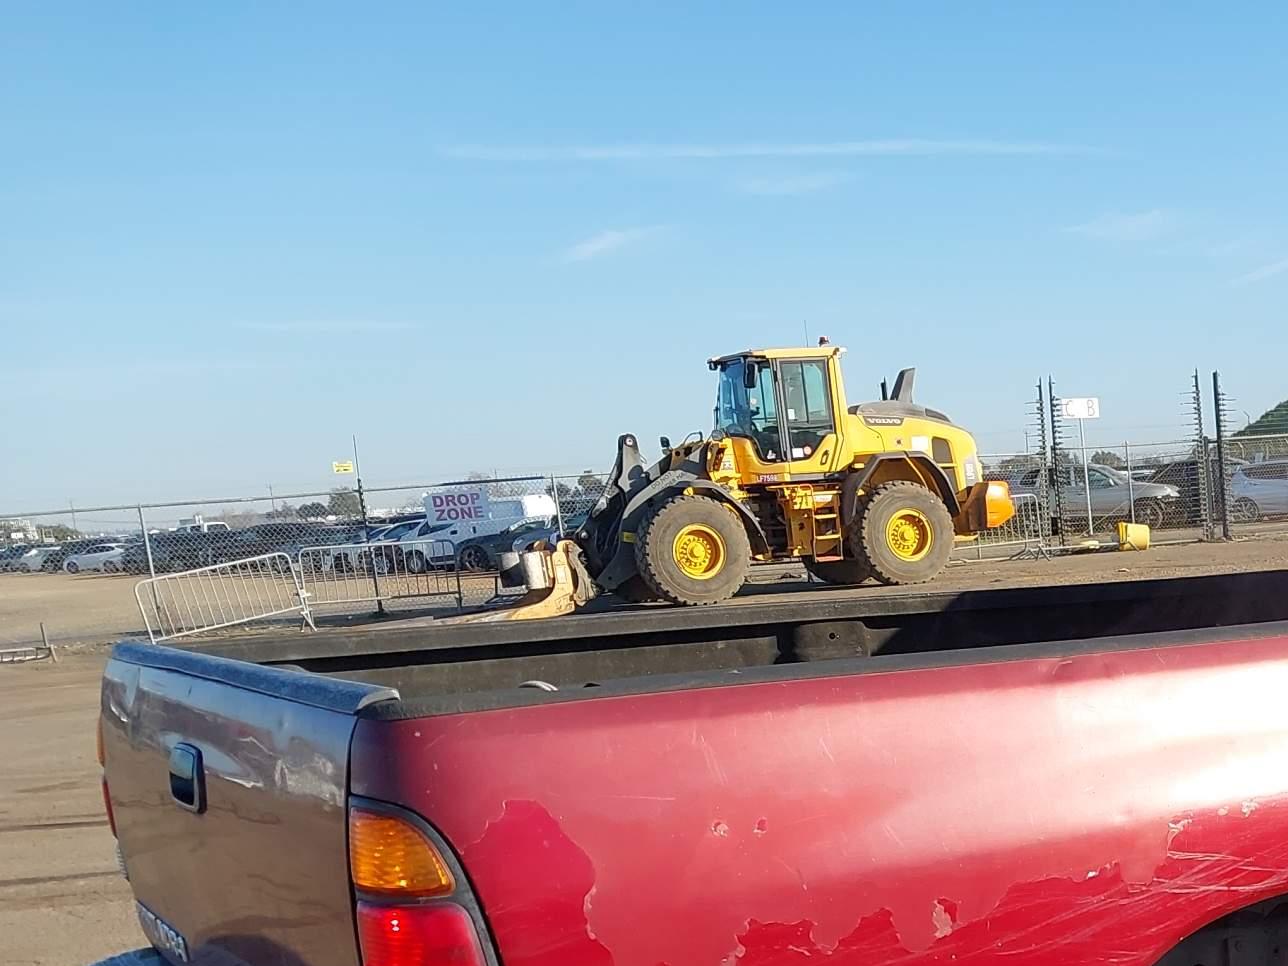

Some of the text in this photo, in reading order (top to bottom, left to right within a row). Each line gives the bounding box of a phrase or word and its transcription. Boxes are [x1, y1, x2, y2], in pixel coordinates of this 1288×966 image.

[1086, 399, 1096, 417] B
[432, 492, 480, 508] DROP
[434, 506, 485, 522] ZONE
